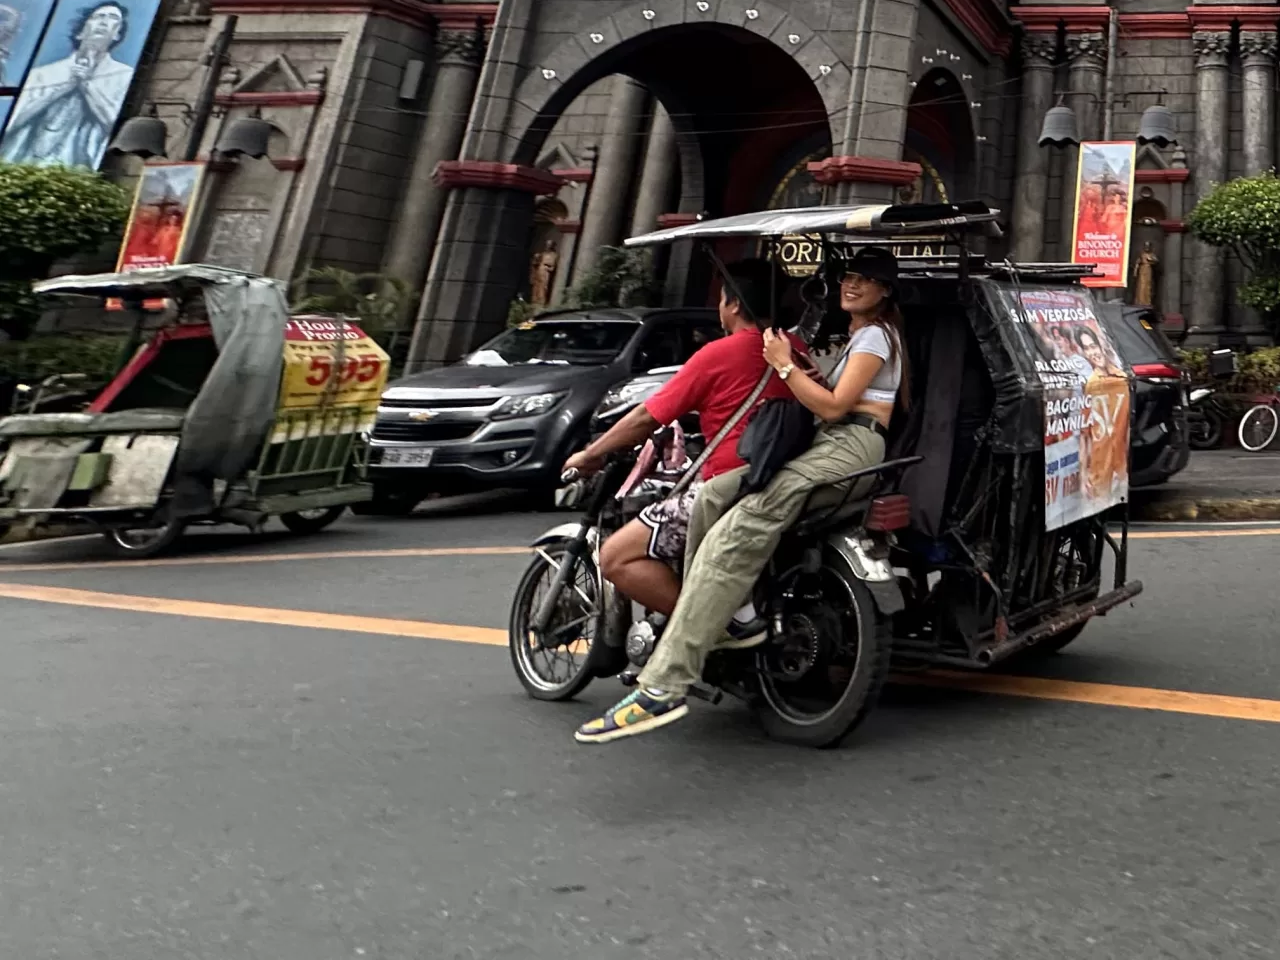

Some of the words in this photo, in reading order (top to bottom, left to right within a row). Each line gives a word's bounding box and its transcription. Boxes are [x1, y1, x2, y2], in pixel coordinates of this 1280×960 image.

[1078, 240, 1122, 249] BINONDO
[1079, 249, 1120, 258] CHURCH
[1039, 307, 1096, 323] VERZOSA
[1046, 394, 1092, 416] BAGONG
[1046, 414, 1094, 436] MAYNILA
[1090, 393, 1125, 442] SV
